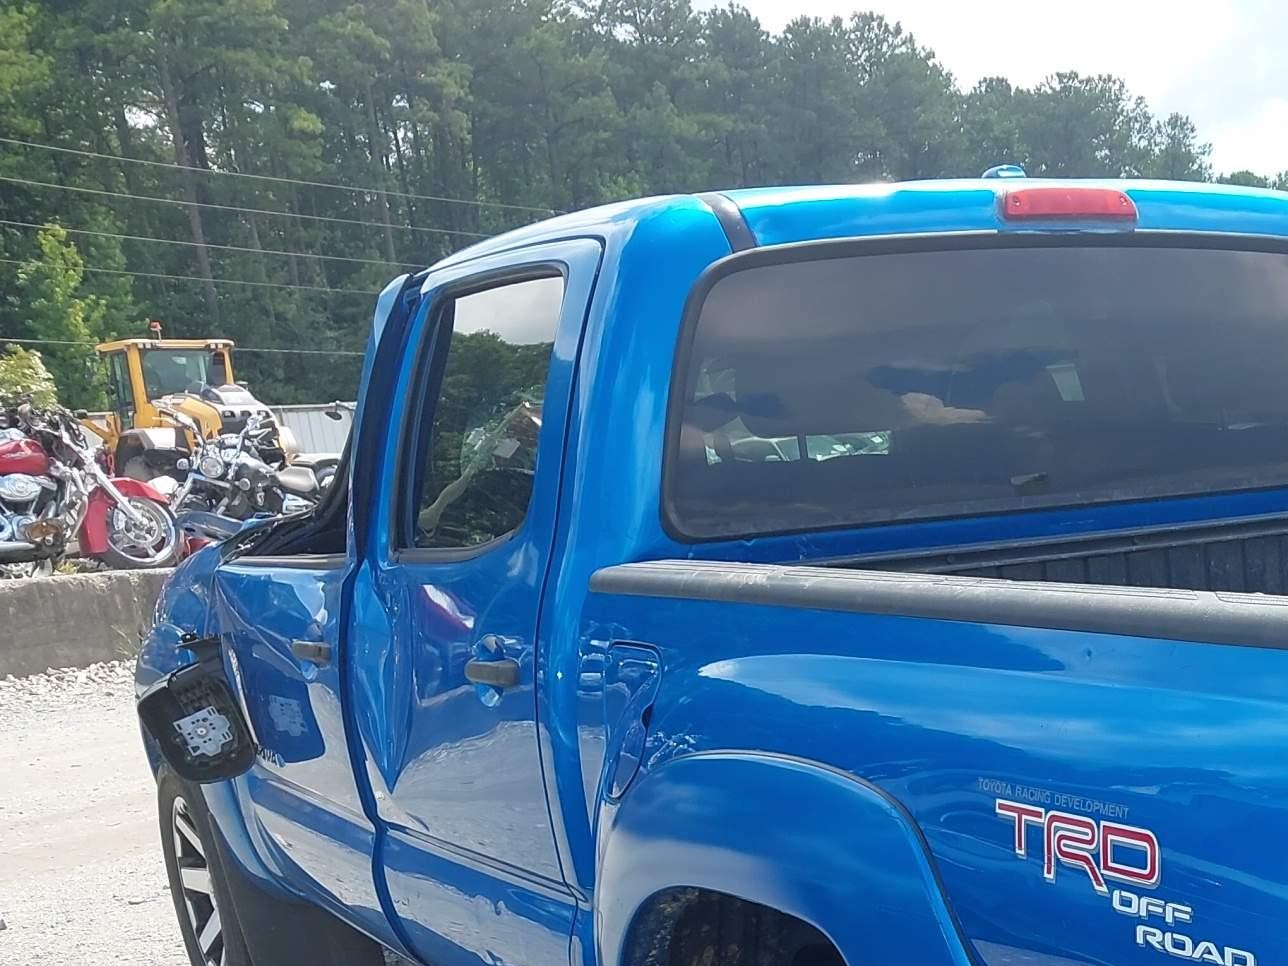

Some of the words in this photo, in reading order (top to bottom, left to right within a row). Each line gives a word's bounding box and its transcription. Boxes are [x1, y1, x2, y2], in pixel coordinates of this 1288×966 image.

[977, 777, 1012, 796] TOYOTA
[1015, 784, 1051, 804] RACING
[1053, 792, 1130, 819] DEVELOPMENT
[995, 798, 1159, 895] TRD
[1112, 889, 1193, 924] OFF
